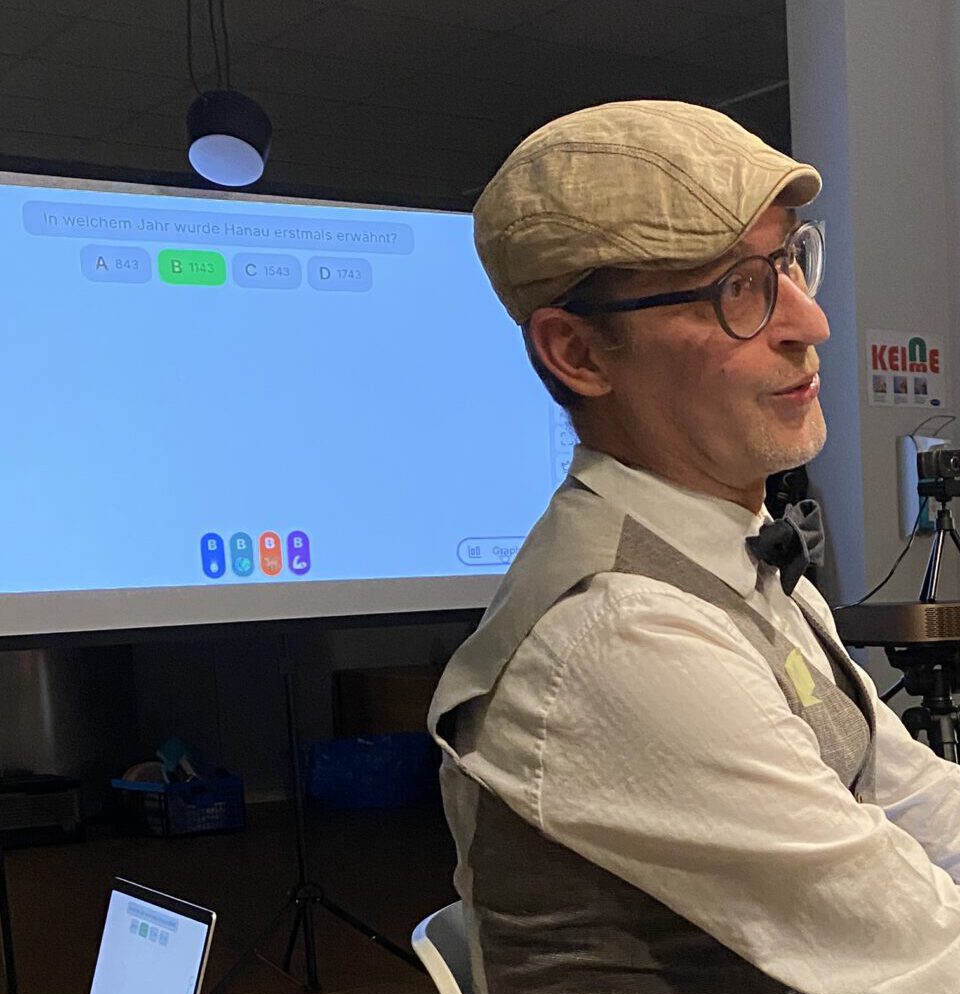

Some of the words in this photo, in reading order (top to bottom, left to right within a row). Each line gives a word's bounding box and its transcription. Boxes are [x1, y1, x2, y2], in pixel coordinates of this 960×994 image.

[43, 212, 58, 225] In
[62, 215, 132, 229] welchem
[137, 218, 170, 232] Jahr
[174, 222, 220, 235] wurde
[224, 223, 270, 237] Hanau
[274, 227, 333, 241] erstmals
[336, 231, 398, 244] erwähnt?
[95, 256, 109, 271] A
[115, 259, 139, 270] 843
[171, 259, 183, 273] B
[189, 261, 215, 273] 1143
[245, 263, 257, 277] C
[264, 265, 290, 277] 1543
[320, 266, 331, 280] D
[337, 269, 362, 280] 1743
[207, 539, 217, 551] B
[236, 538, 247, 550] B
[264, 537, 275, 549] B
[293, 537, 304, 548] B
